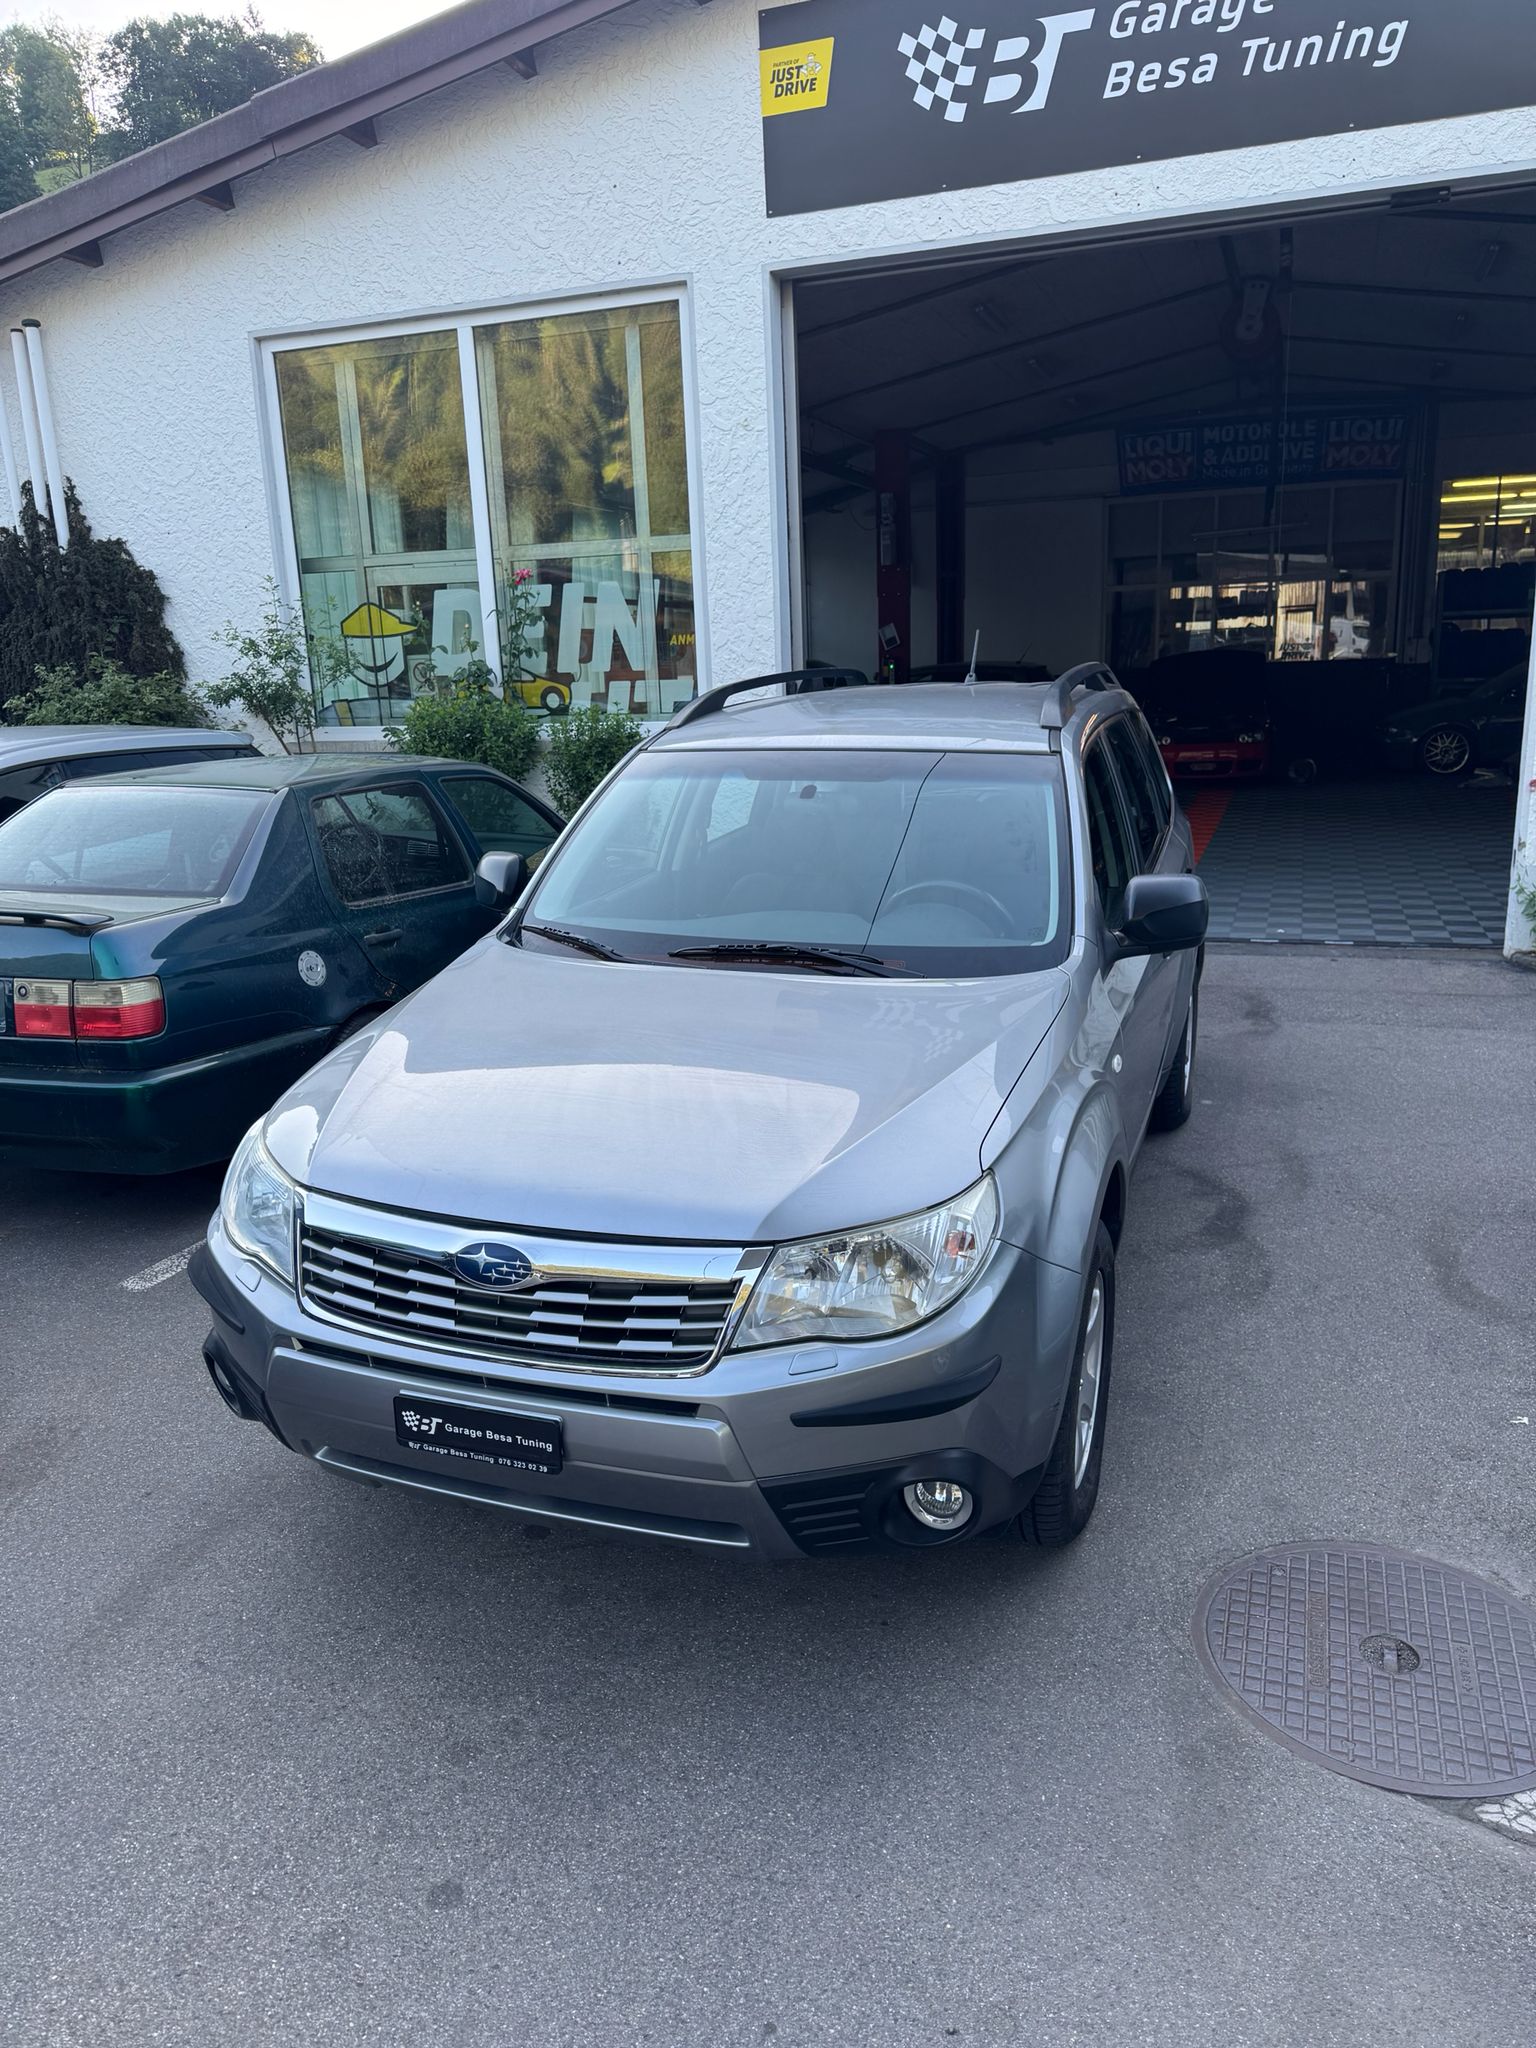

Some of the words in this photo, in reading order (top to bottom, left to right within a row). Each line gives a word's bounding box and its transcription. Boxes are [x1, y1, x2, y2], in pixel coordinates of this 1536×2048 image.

[773, 59, 793, 67] PARTNER
[1103, 52, 1219, 99] Besa
[1240, 20, 1409, 77] Tuning
[770, 65, 803, 84] JUST
[774, 77, 817, 98] DRIVE
[1329, 418, 1404, 442] LIQUI
[1124, 432, 1193, 459] LIQUI
[1203, 448, 1217, 466] &
[1326, 441, 1401, 468] MOLY
[1126, 455, 1194, 482] MOLY
[445, 1423, 483, 1438] Garage
[486, 1431, 512, 1443] Besa
[516, 1436, 553, 1452] Tuning
[423, 1443, 448, 1454] Garage
[450, 1449, 468, 1458] Besa
[470, 1453, 494, 1464] Tuning
[513, 1460, 526, 1469] 323
